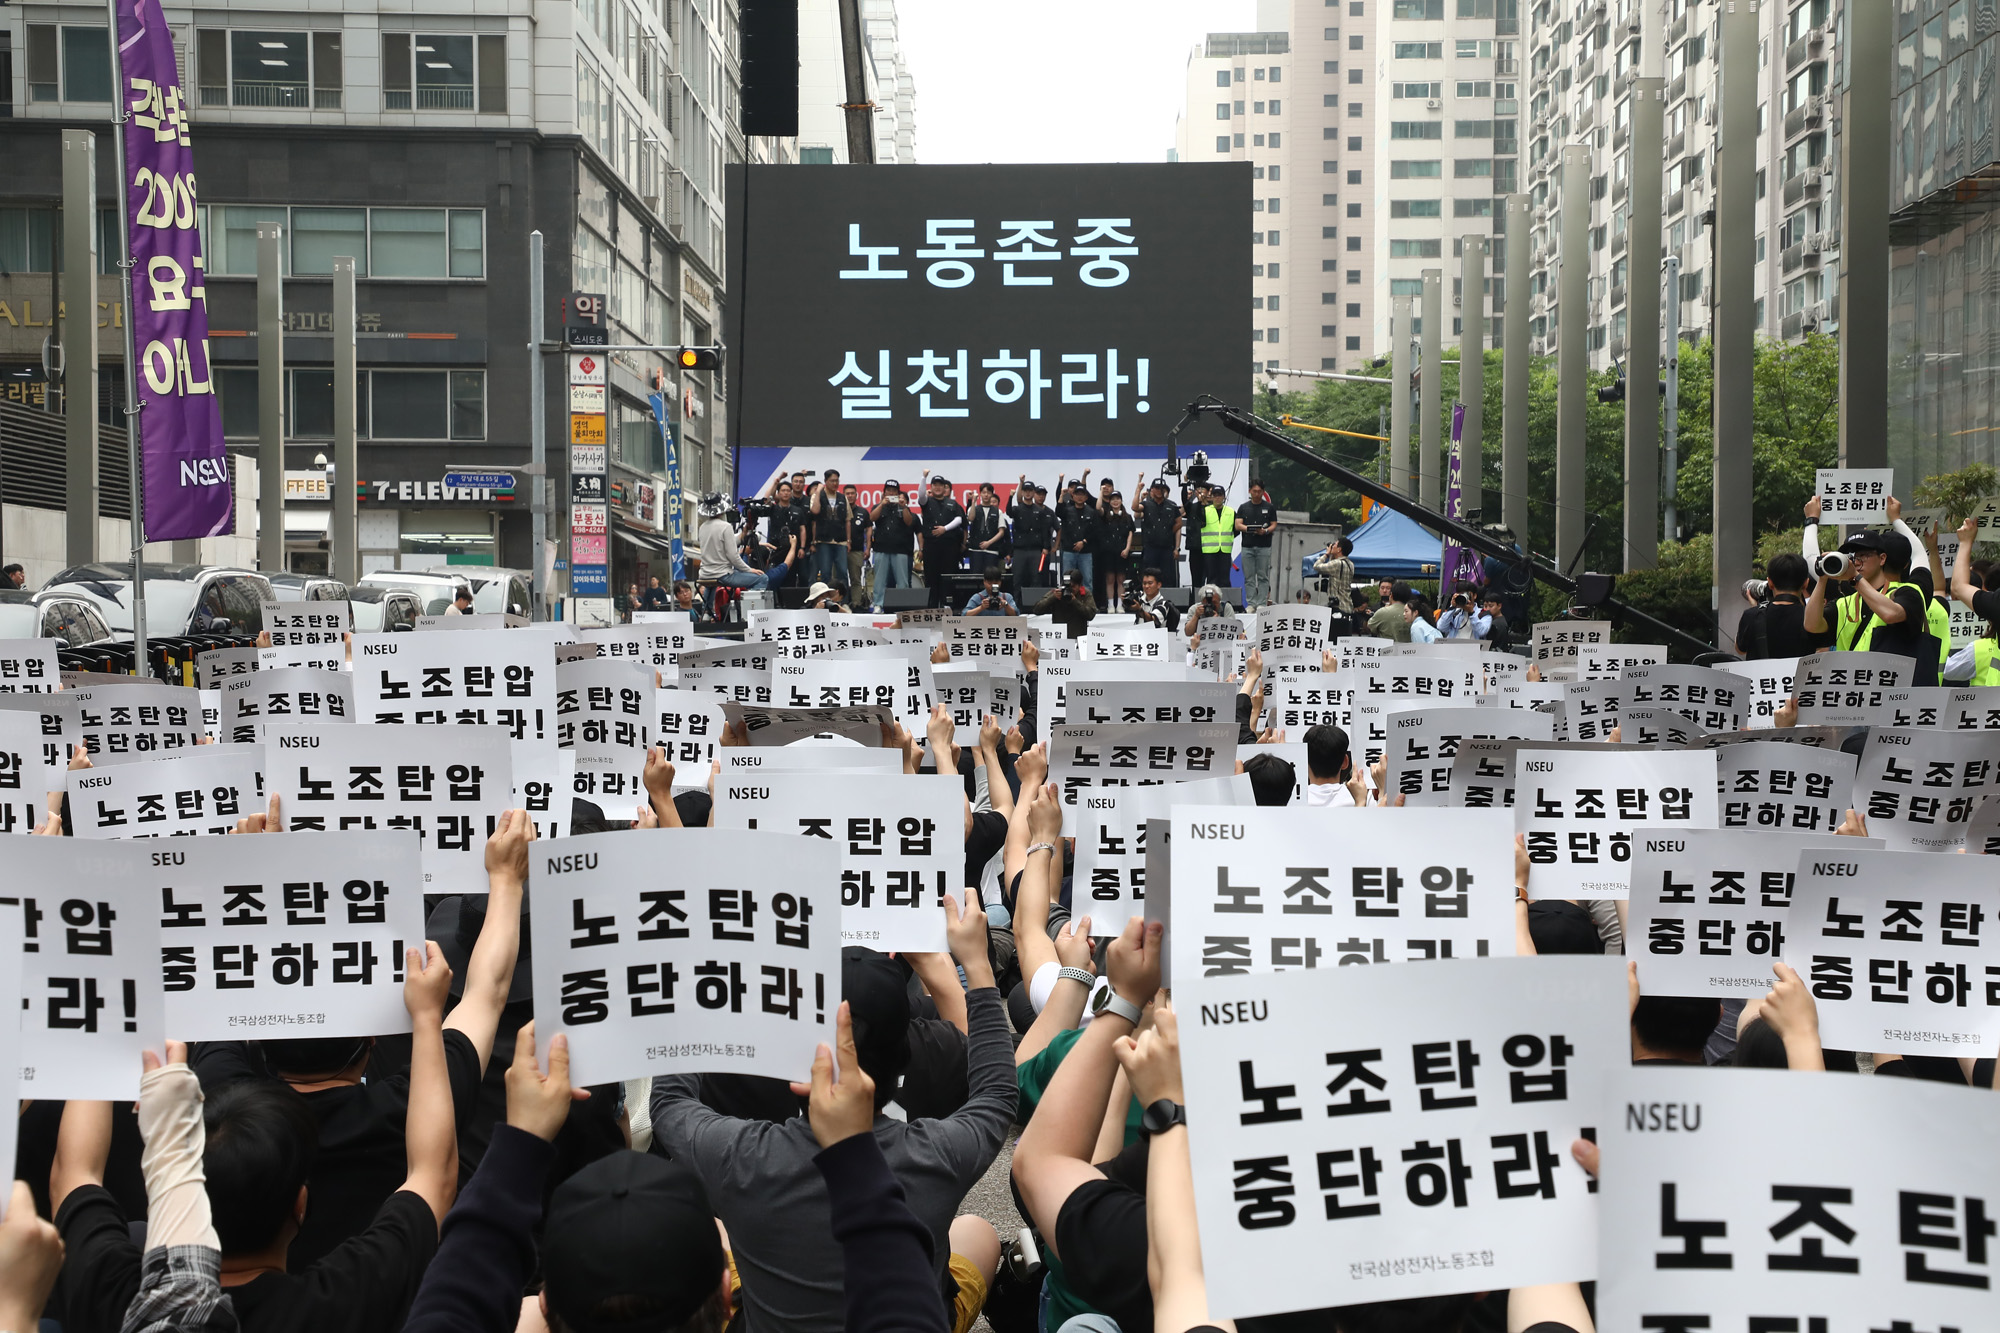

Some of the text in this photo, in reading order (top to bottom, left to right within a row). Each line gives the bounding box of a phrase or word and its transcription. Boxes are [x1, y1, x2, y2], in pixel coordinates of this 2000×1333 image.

[839, 218, 1139, 288] 노동존중
[828, 348, 1151, 420] 실천하라!
[572, 452, 604, 465] 아카사카
[286, 479, 325, 493] FFEE
[1825, 482, 1884, 495] 노조탄압
[1821, 498, 1886, 512] 중단하라!
[574, 513, 604, 525] 부동산
[274, 614, 340, 628] 노조탄압
[1263, 619, 1322, 633] 노조탄압
[761, 624, 826, 642] 노조탄압
[953, 628, 1018, 639] 노조탄압
[1541, 632, 1601, 644] 노조탄압
[364, 644, 397, 655] NSEU
[596, 642, 640, 657] 조탄압
[779, 643, 832, 659] 단하라!
[951, 643, 1021, 656] 중단하라!
[1096, 643, 1159, 656] 노조탄압
[1261, 635, 1323, 652] 중단하라!
[1803, 658, 1820, 666] NSEU
[781, 666, 805, 675] NSEU
[1805, 670, 1898, 687] 노조탄압
[228, 680, 251, 691] NSEU
[380, 665, 534, 700] 노조탄압
[1369, 677, 1454, 697] 노조탄압
[1570, 686, 1590, 694] NSEU
[76, 693, 92, 701] SEU
[557, 687, 641, 715] 조탄압
[789, 685, 895, 708] 노조탄압
[1634, 685, 1735, 707] 노조탄압
[238, 692, 345, 718] 노조탄압
[81, 706, 187, 727] 노조탄압
[1398, 718, 1423, 728] NSEU
[1628, 712, 1653, 720] NSEU
[280, 736, 320, 748] NSEU
[558, 720, 647, 750] 단하라!
[1878, 735, 1911, 745] NSEU
[731, 757, 761, 766] NSEU
[1072, 746, 1215, 771] 노조탄압
[1526, 761, 1554, 772] NSEU
[79, 776, 112, 789] NSEU
[297, 765, 484, 801] 노조탄압
[729, 787, 769, 799] NSEU
[97, 786, 239, 827] 노조탄압
[1088, 798, 1115, 809] NSEU
[1534, 787, 1693, 820] 노조탄압
[1725, 802, 1837, 831] 단하라!
[1192, 824, 1245, 840] NSEU
[1646, 840, 1685, 853] NSEU
[152, 852, 185, 866] SEU
[547, 853, 599, 875] NSEU
[1812, 863, 1858, 877] NSEU
[1213, 865, 1473, 918] 노조탄압
[161, 879, 389, 928] 노조탄압
[570, 889, 813, 950] 노조탄압
[161, 940, 404, 992] 중단하라!
[560, 960, 825, 1026] 중단하라!
[228, 1012, 326, 1027] 전국삼성전자노동조합
[1200, 999, 1269, 1026] NSEU
[1883, 1029, 1981, 1045] 전국삼성전자노동조합
[645, 1043, 755, 1060] 전국삼성전자노동조합
[1238, 1033, 1574, 1126] 노조탄압
[1626, 1103, 1701, 1132] NSEU
[1348, 1250, 1494, 1281] 전국삼성전자노동조합
